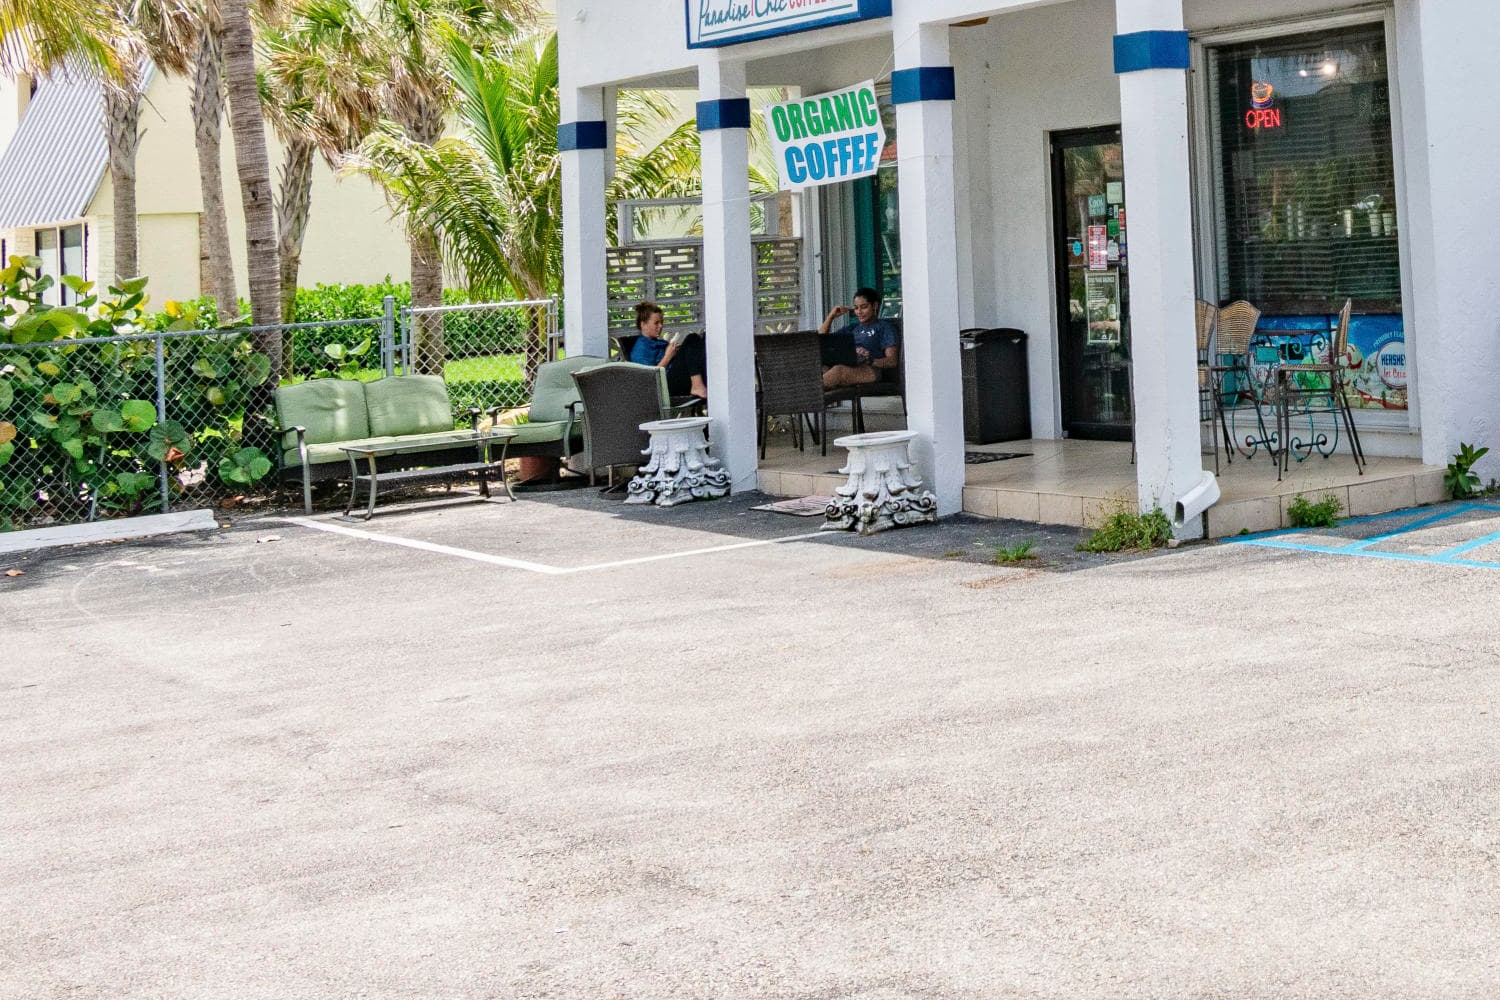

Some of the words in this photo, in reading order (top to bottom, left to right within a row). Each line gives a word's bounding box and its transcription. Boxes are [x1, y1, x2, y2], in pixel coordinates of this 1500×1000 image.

[771, 88, 878, 142] ORGANIC
[1245, 108, 1281, 128] OPEN
[785, 132, 879, 183] COFFEE
